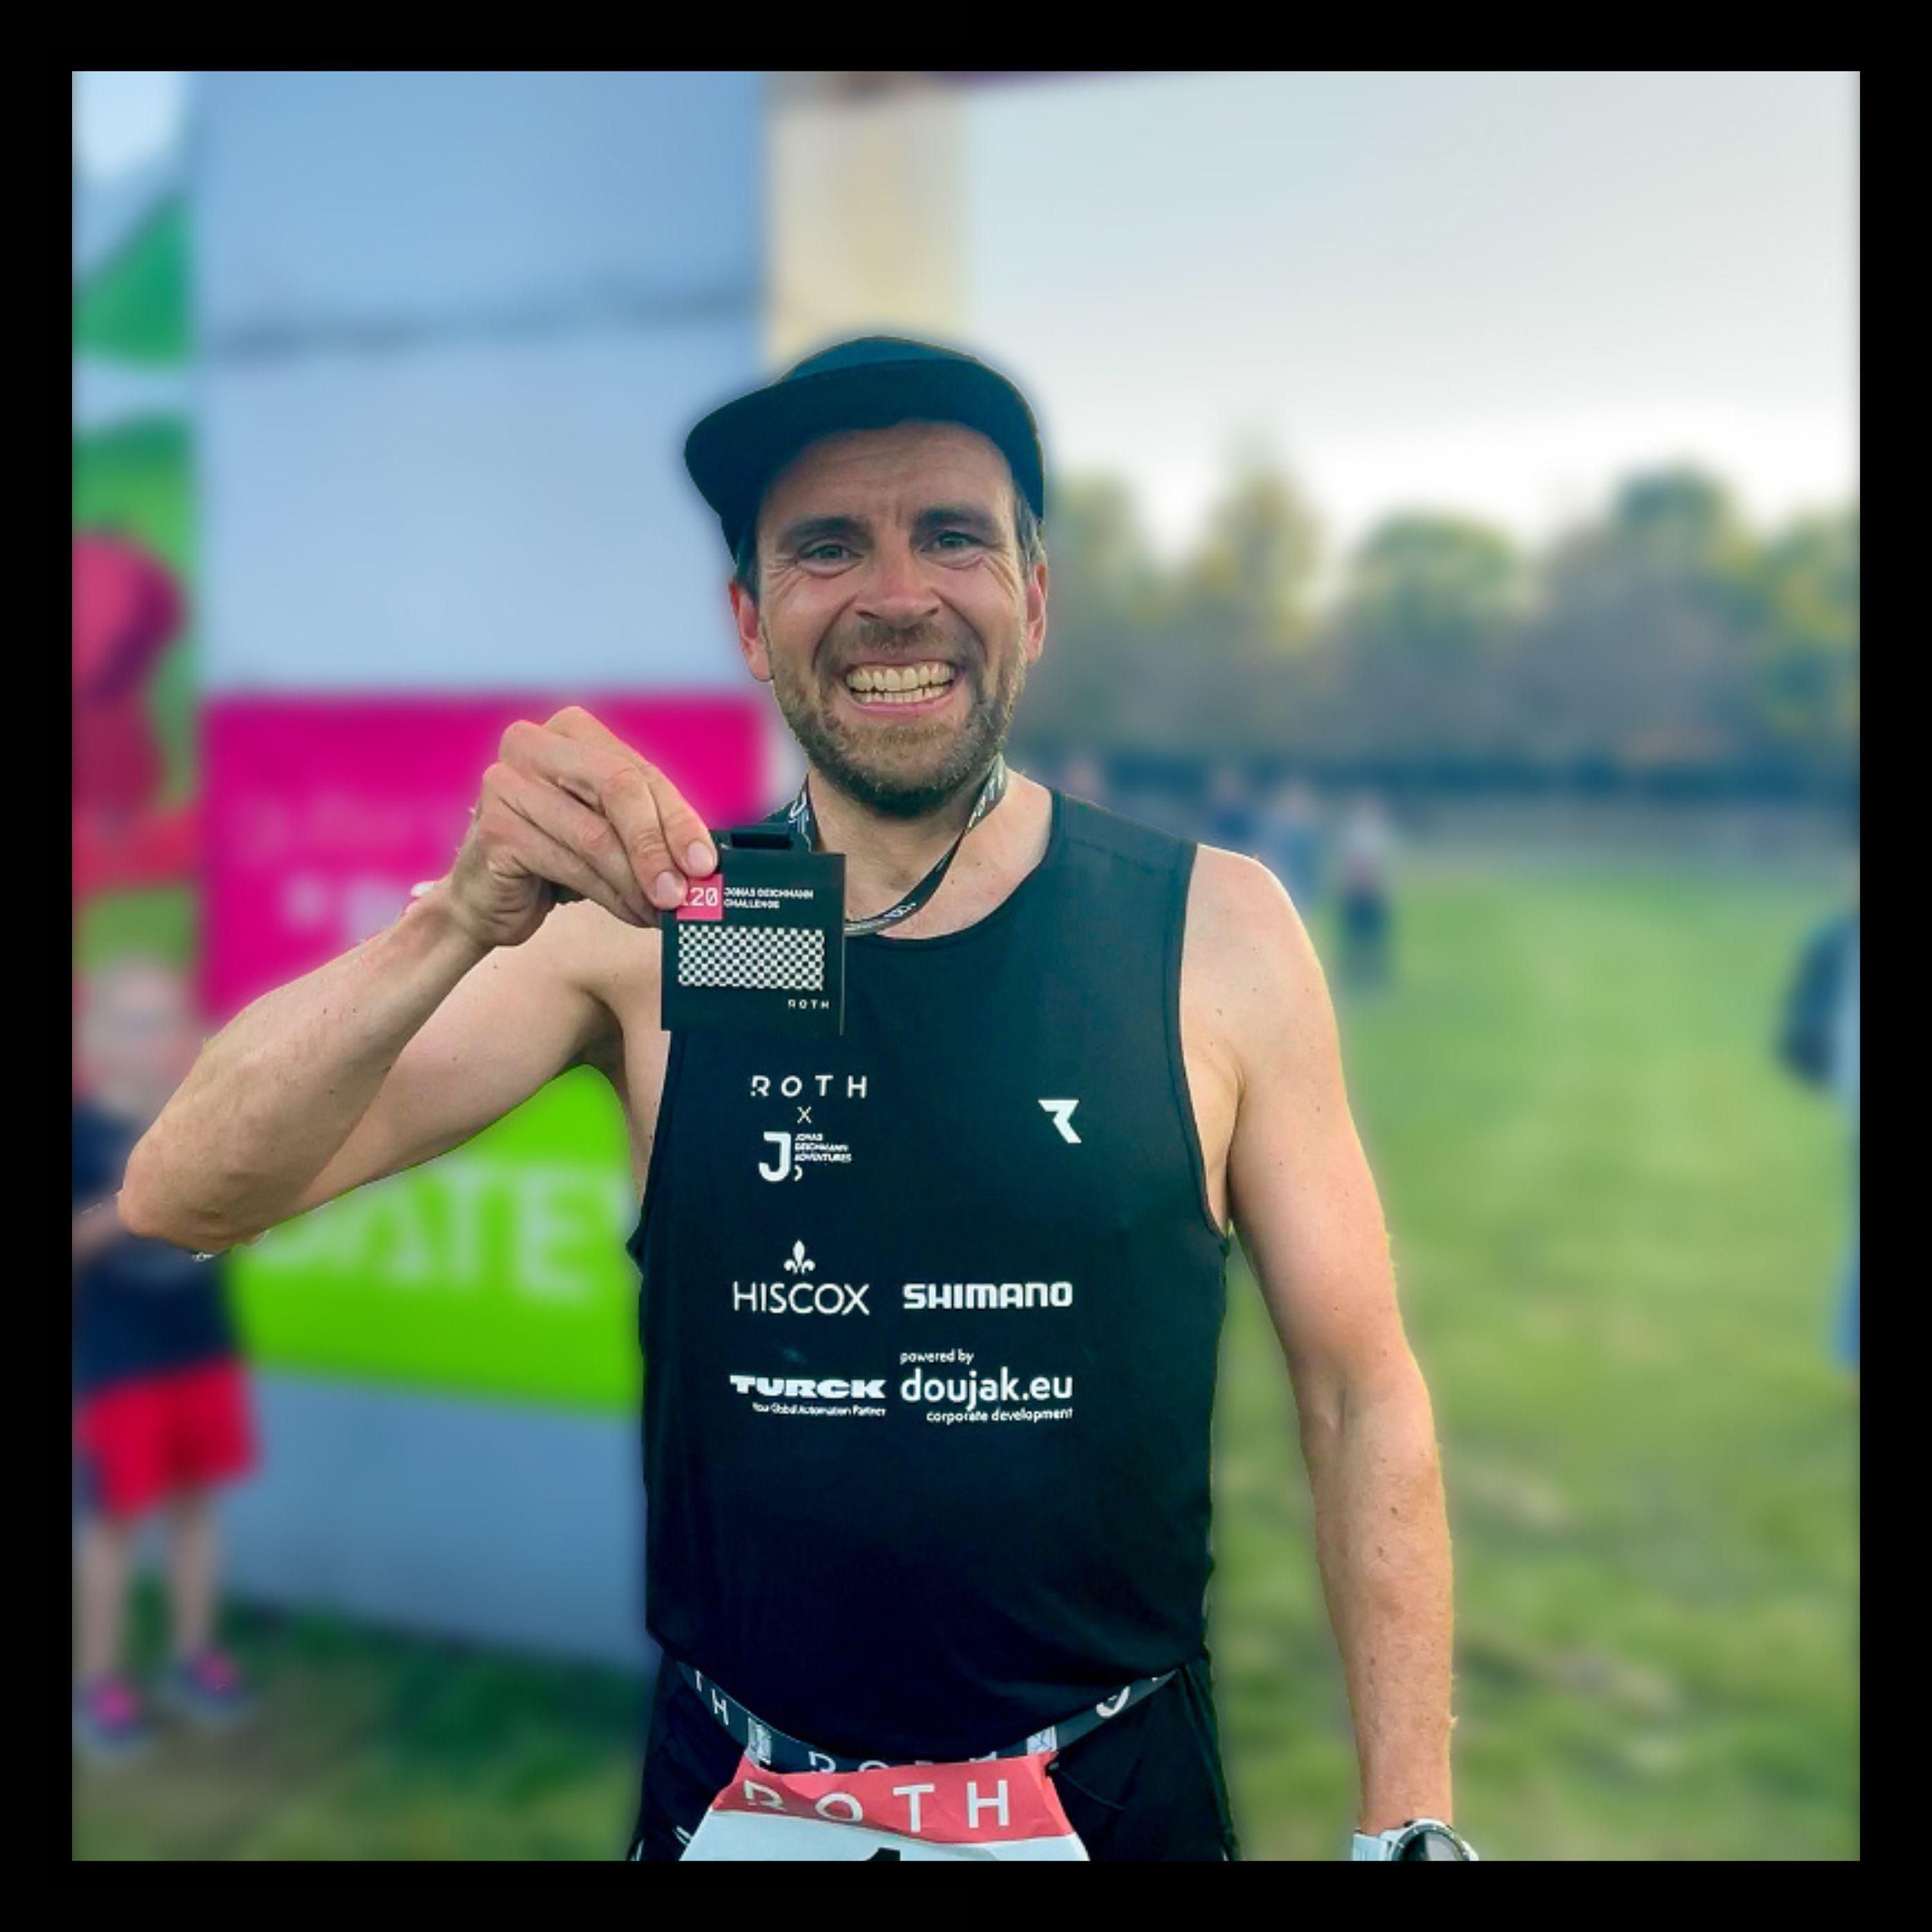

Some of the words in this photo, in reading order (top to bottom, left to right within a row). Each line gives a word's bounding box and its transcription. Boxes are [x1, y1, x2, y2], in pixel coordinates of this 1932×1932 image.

[684, 887, 718, 907] 20
[723, 898, 781, 909] CHALLENGE
[788, 999, 829, 1009] ROTH
[750, 1074, 867, 1099] ROTH
[732, 1280, 871, 1316] HISCOX
[902, 1281, 1074, 1311] SHIMANO
[900, 1349, 956, 1366] powered
[958, 1349, 974, 1366] by
[729, 1374, 887, 1399] TURCK
[900, 1365, 1074, 1412] doujak.eu
[925, 1410, 989, 1426] corporate
[990, 1406, 1074, 1424] development
